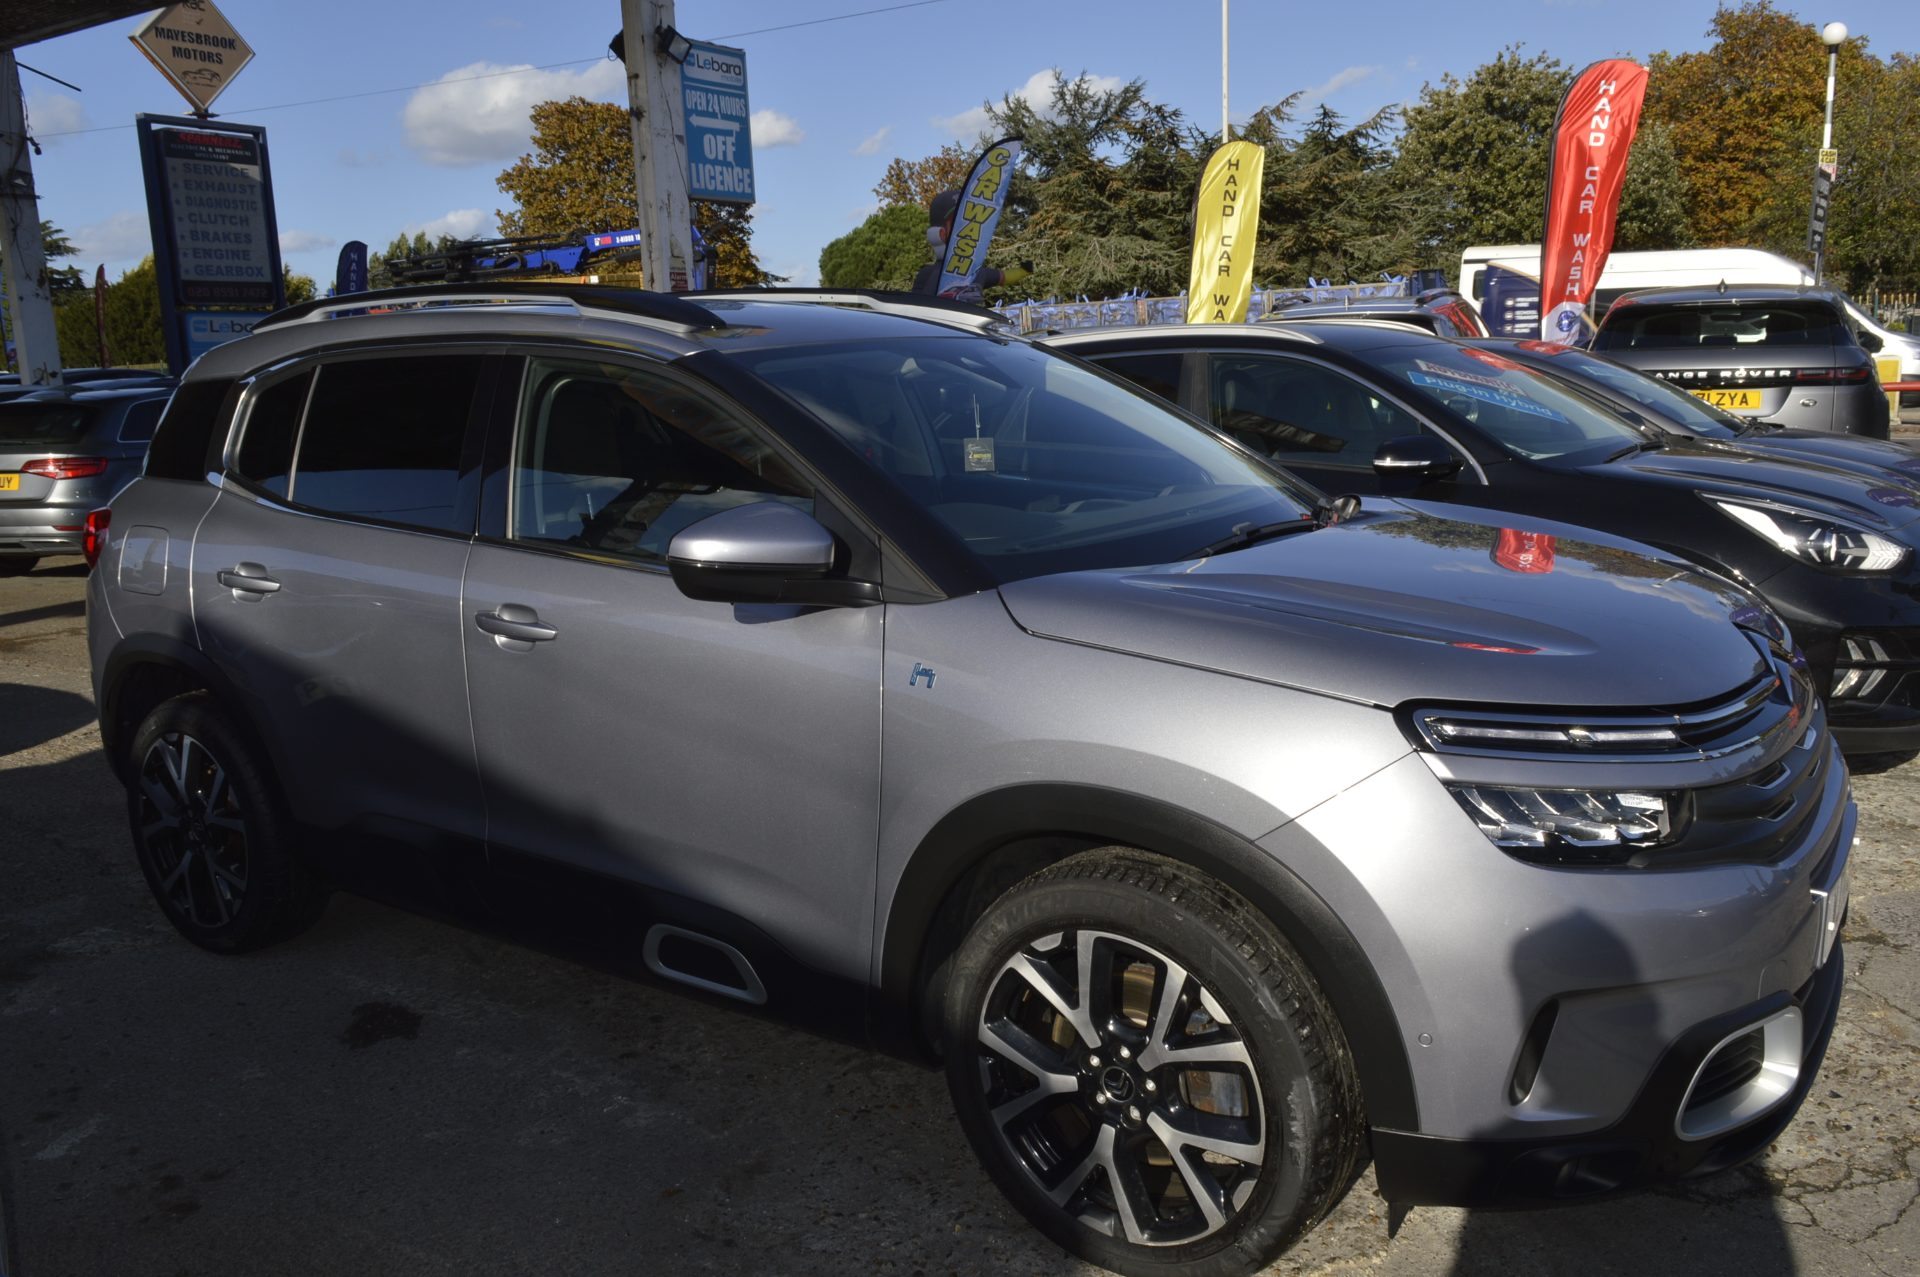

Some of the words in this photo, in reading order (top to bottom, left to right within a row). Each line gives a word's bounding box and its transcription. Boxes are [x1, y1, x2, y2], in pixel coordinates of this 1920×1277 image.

[154, 26, 237, 50] MAYESBROOK
[171, 46, 224, 65] MOTORS
[696, 54, 742, 76] Lebara
[685, 89, 707, 111] OPEN
[707, 93, 720, 115] 24
[720, 95, 746, 117] HOURS
[1588, 79, 1616, 147] HAND
[703, 133, 736, 162] OFF
[182, 162, 250, 178] SERVICE
[690, 162, 752, 193] LICENCE
[971, 147, 1011, 201] CAR
[183, 180, 256, 195] EXHAUST
[1222, 159, 1240, 217] HAND
[1580, 166, 1600, 214] CAR
[186, 196, 258, 212] DIAGNOSTIC
[188, 213, 249, 226] CLUTCH
[190, 229, 252, 244] BRAKES
[945, 200, 996, 277] WASH
[192, 247, 252, 261] ENGINE
[1218, 235, 1232, 277] CAR
[1565, 233, 1591, 296] WASH
[194, 264, 265, 278] GEARBOX
[350, 252, 358, 291] HAND
[1213, 293, 1230, 321] WA
[209, 320, 253, 333] Leba
[1655, 371, 1708, 379] ANGE
[1720, 369, 1792, 378] ROVER
[1424, 375, 1491, 398] Plug-in
[1715, 392, 1749, 406] ZYA
[0, 476, 13, 489] UY
